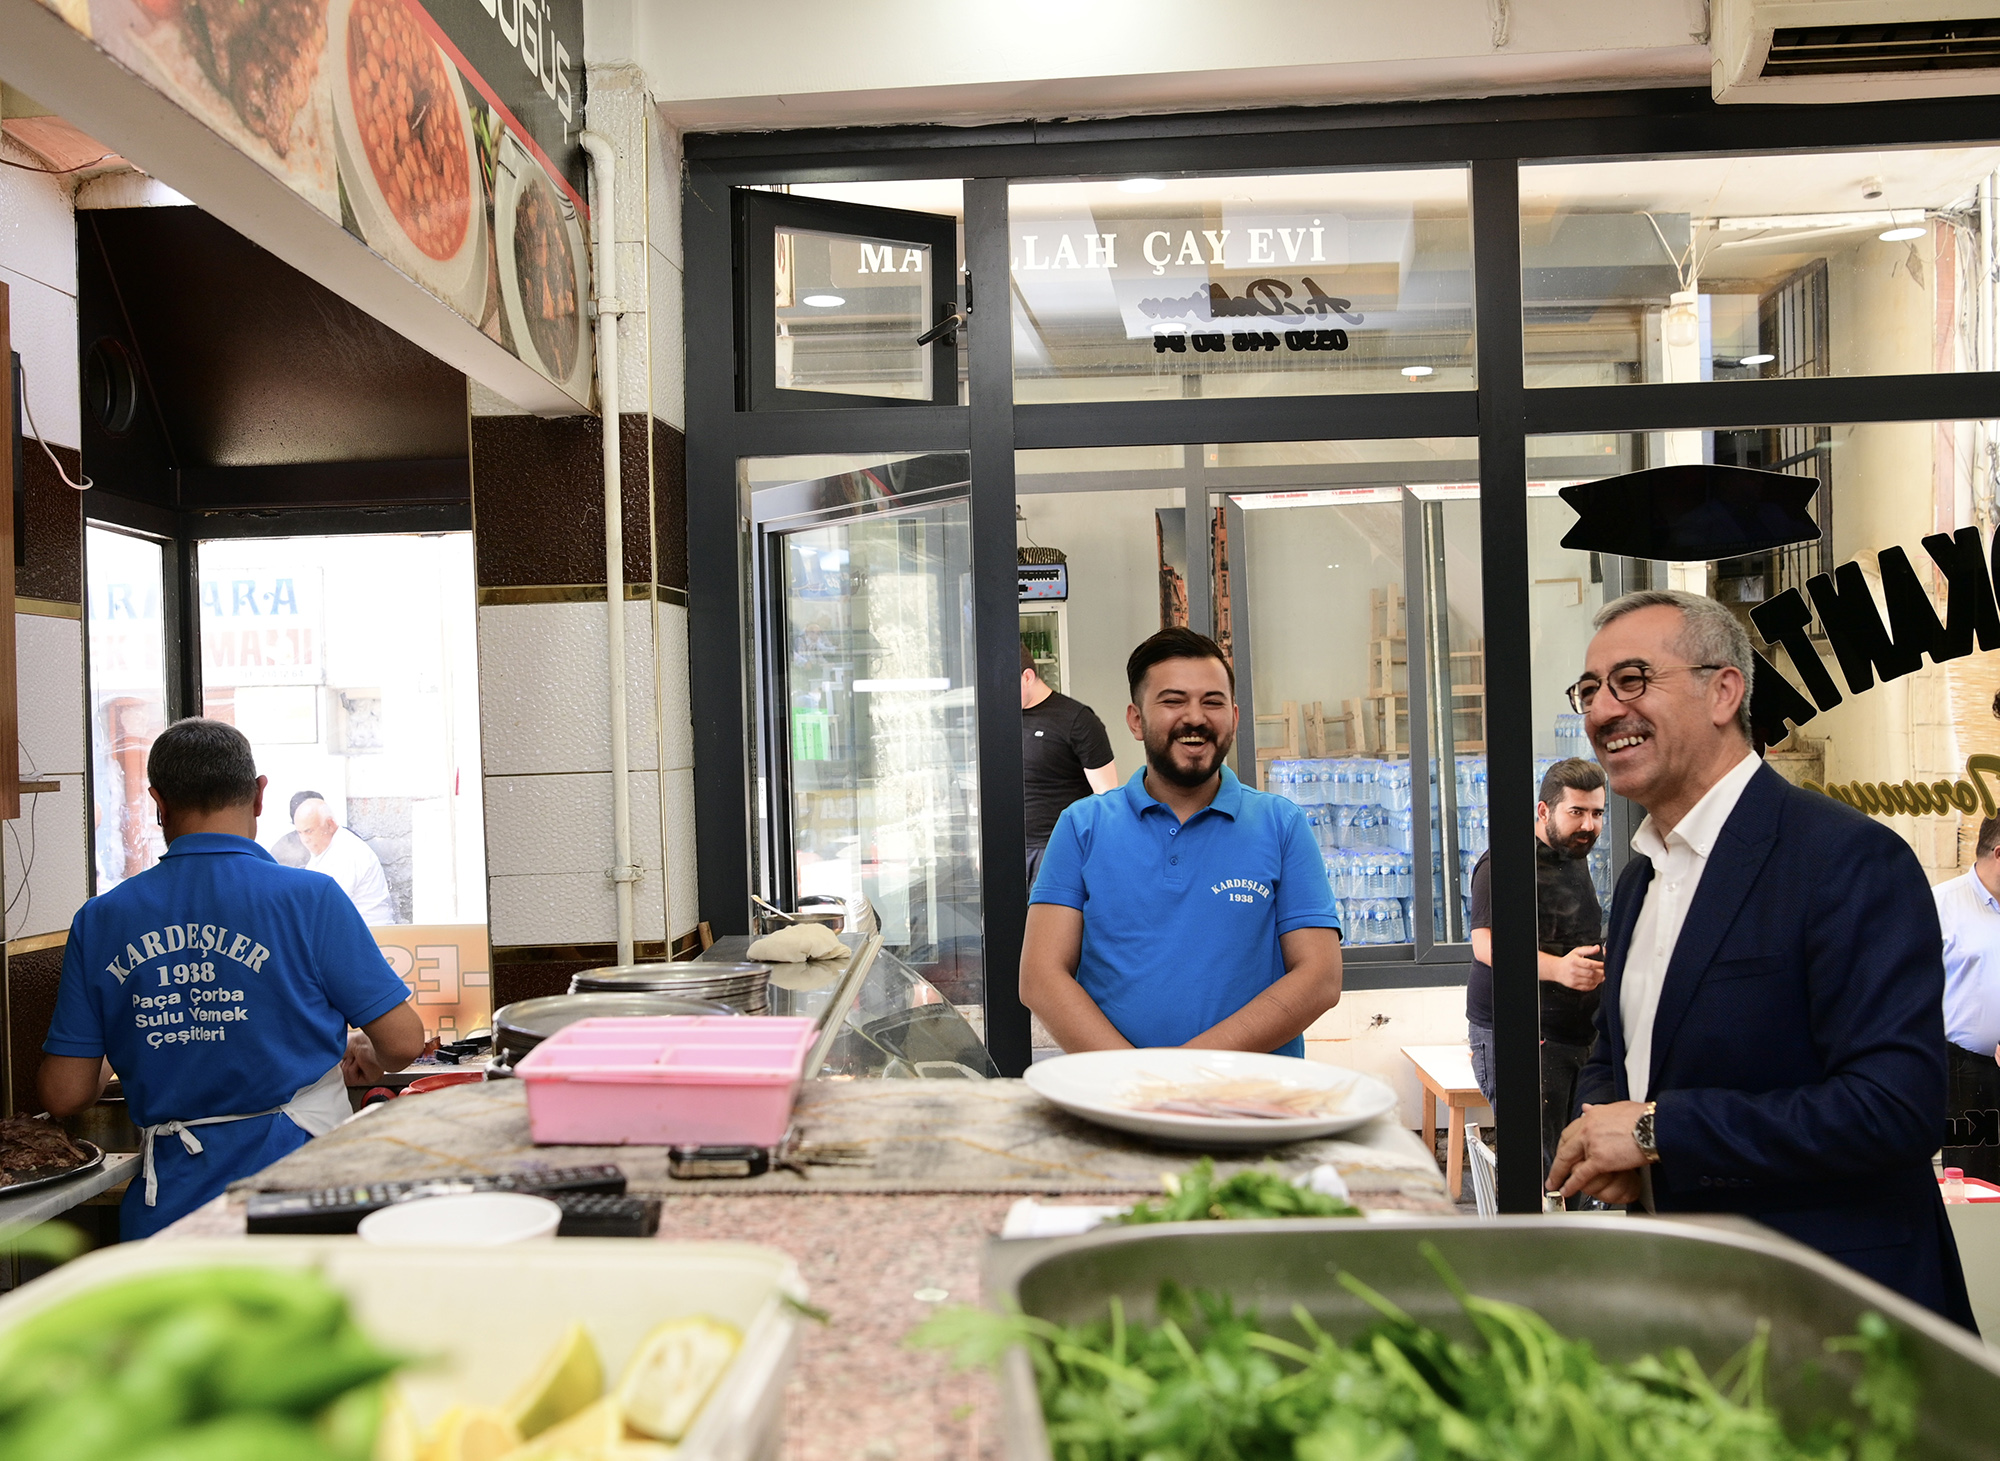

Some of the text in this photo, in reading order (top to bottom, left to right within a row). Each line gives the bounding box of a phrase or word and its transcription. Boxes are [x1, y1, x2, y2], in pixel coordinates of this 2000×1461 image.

[1142, 229, 1231, 276] ÇAY
[1246, 218, 1326, 264] EVİ
[1210, 878, 1270, 899] KARDEŞLER
[1229, 893, 1254, 903] 1938
[105, 923, 271, 986] KARDEŞLER
[156, 961, 217, 987] 1938
[132, 987, 245, 1011] Paça Çorba
[135, 1006, 249, 1028] Sulu Yemek
[146, 1026, 225, 1050] Çeşitleri
